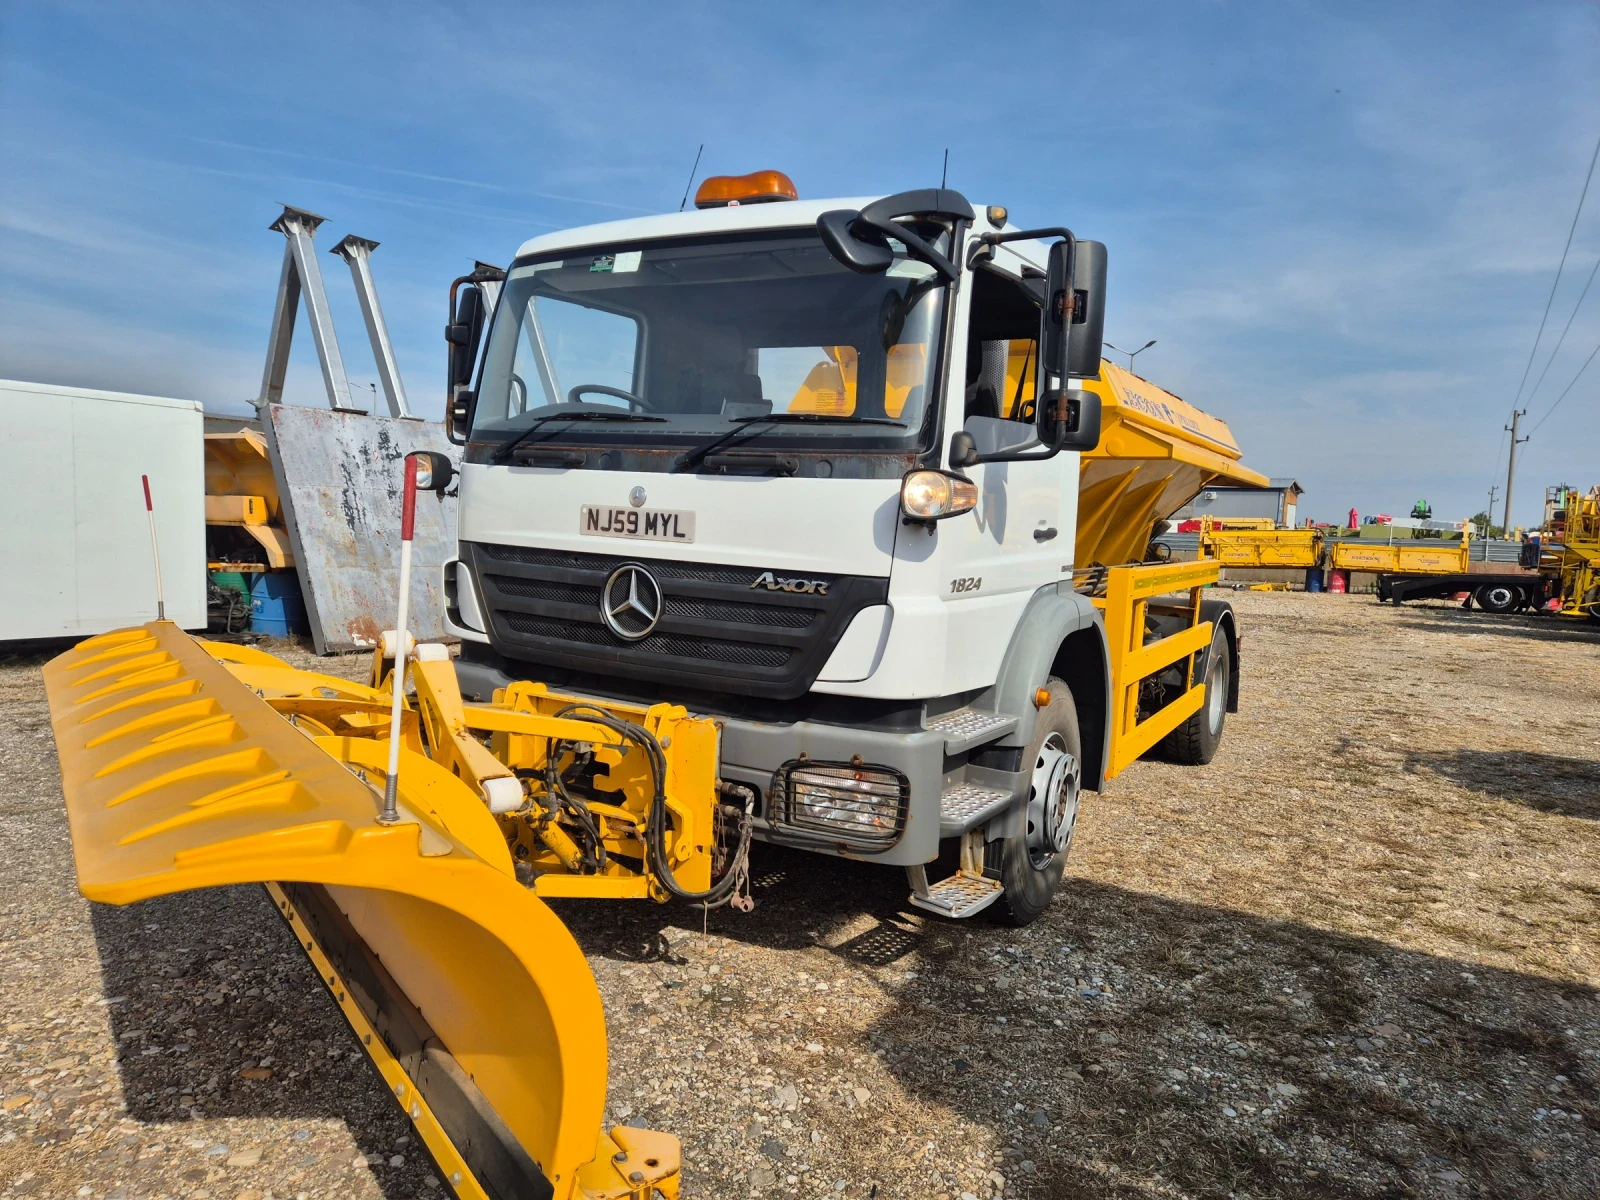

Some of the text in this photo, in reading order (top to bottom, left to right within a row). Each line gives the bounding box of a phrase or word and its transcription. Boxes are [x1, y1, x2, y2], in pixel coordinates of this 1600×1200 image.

[586, 508, 686, 538] NJ59 MYL
[750, 571, 829, 595] AXOR
[950, 577, 982, 593] 1824
